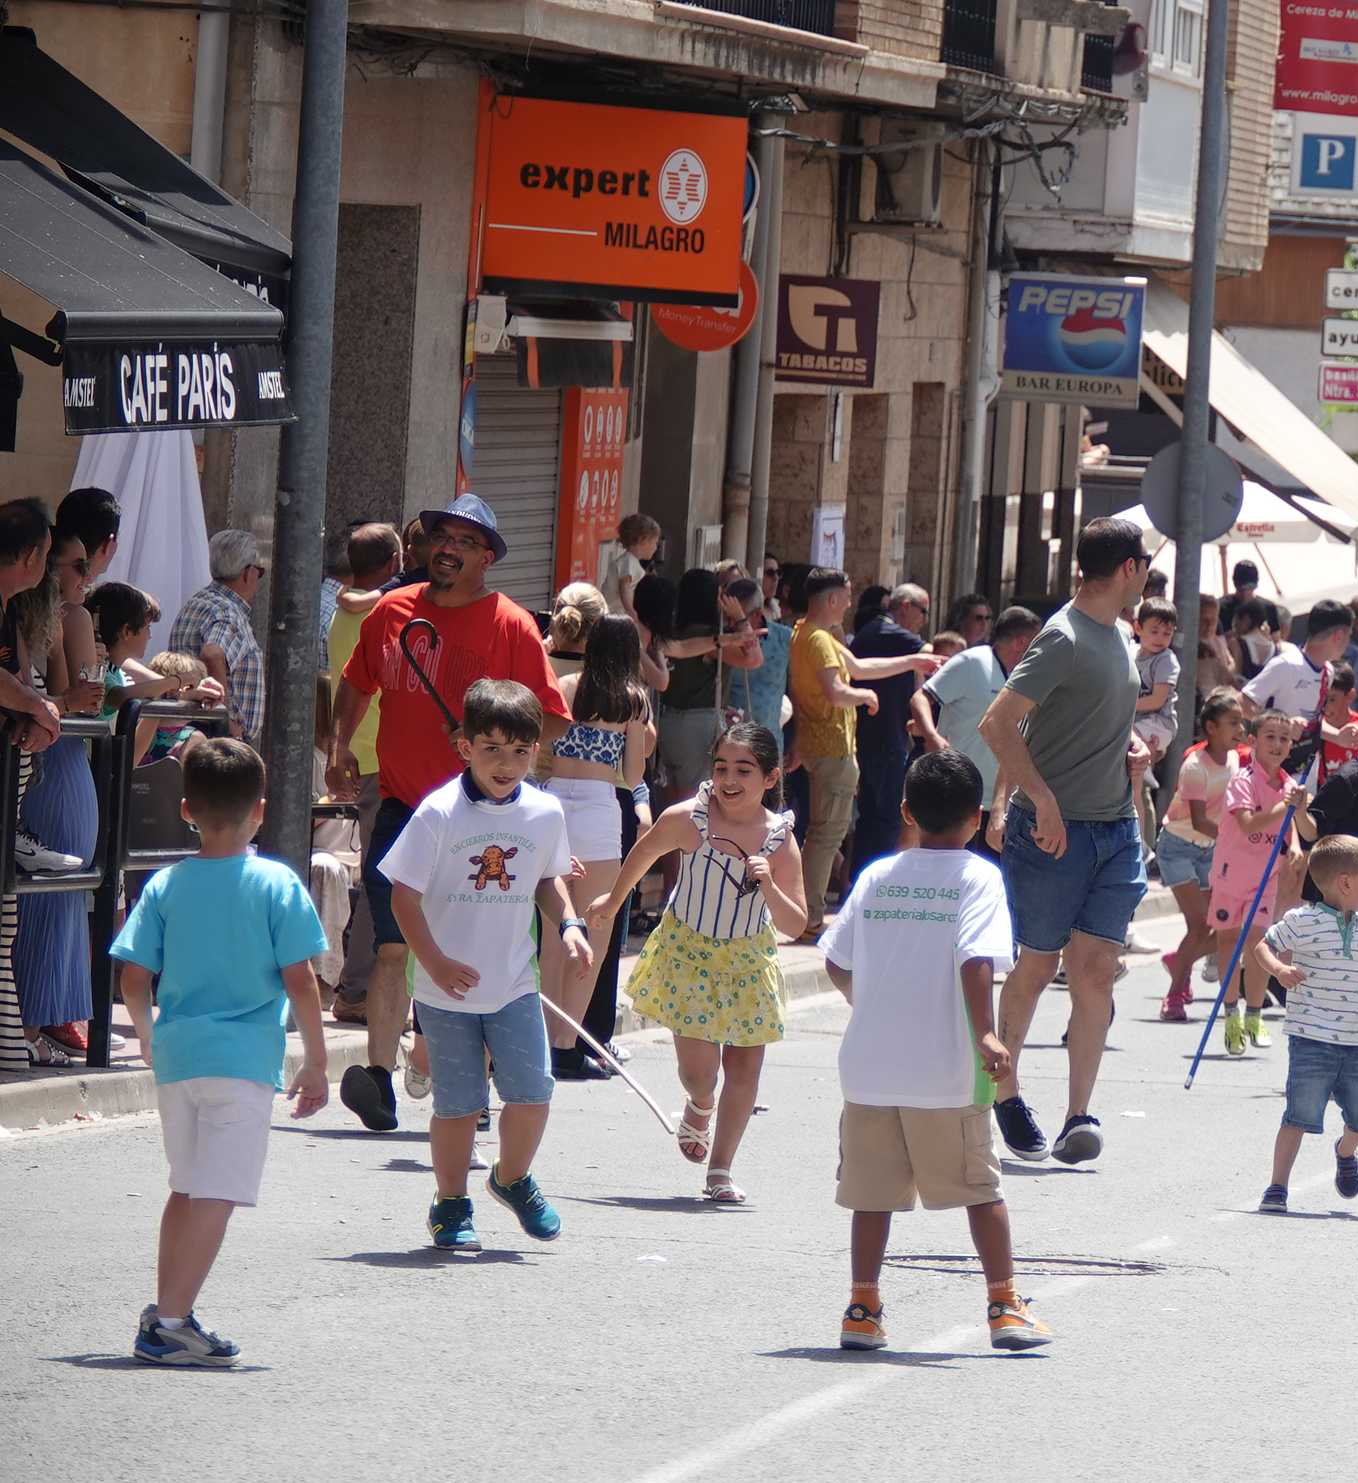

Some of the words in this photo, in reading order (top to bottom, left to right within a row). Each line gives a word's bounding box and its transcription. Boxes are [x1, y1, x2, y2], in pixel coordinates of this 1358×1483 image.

[1287, 4, 1326, 17] Cereza
[1328, 8, 1343, 18] de
[1316, 139, 1345, 175] P
[520, 161, 651, 198] expert
[604, 222, 705, 253] MILAGRO
[1018, 286, 1134, 319] PEPSI
[779, 353, 867, 372] TABACOS
[64, 376, 96, 407] AMSTEL
[121, 343, 168, 423] CAFÉ
[178, 342, 236, 420] PARÍS
[258, 371, 285, 399] AMSTEL
[1016, 376, 1050, 391] BAR
[1055, 379, 1122, 395] EUROPA
[887, 886, 909, 898] 639
[912, 887, 936, 900] 520
[937, 887, 960, 900] 445
